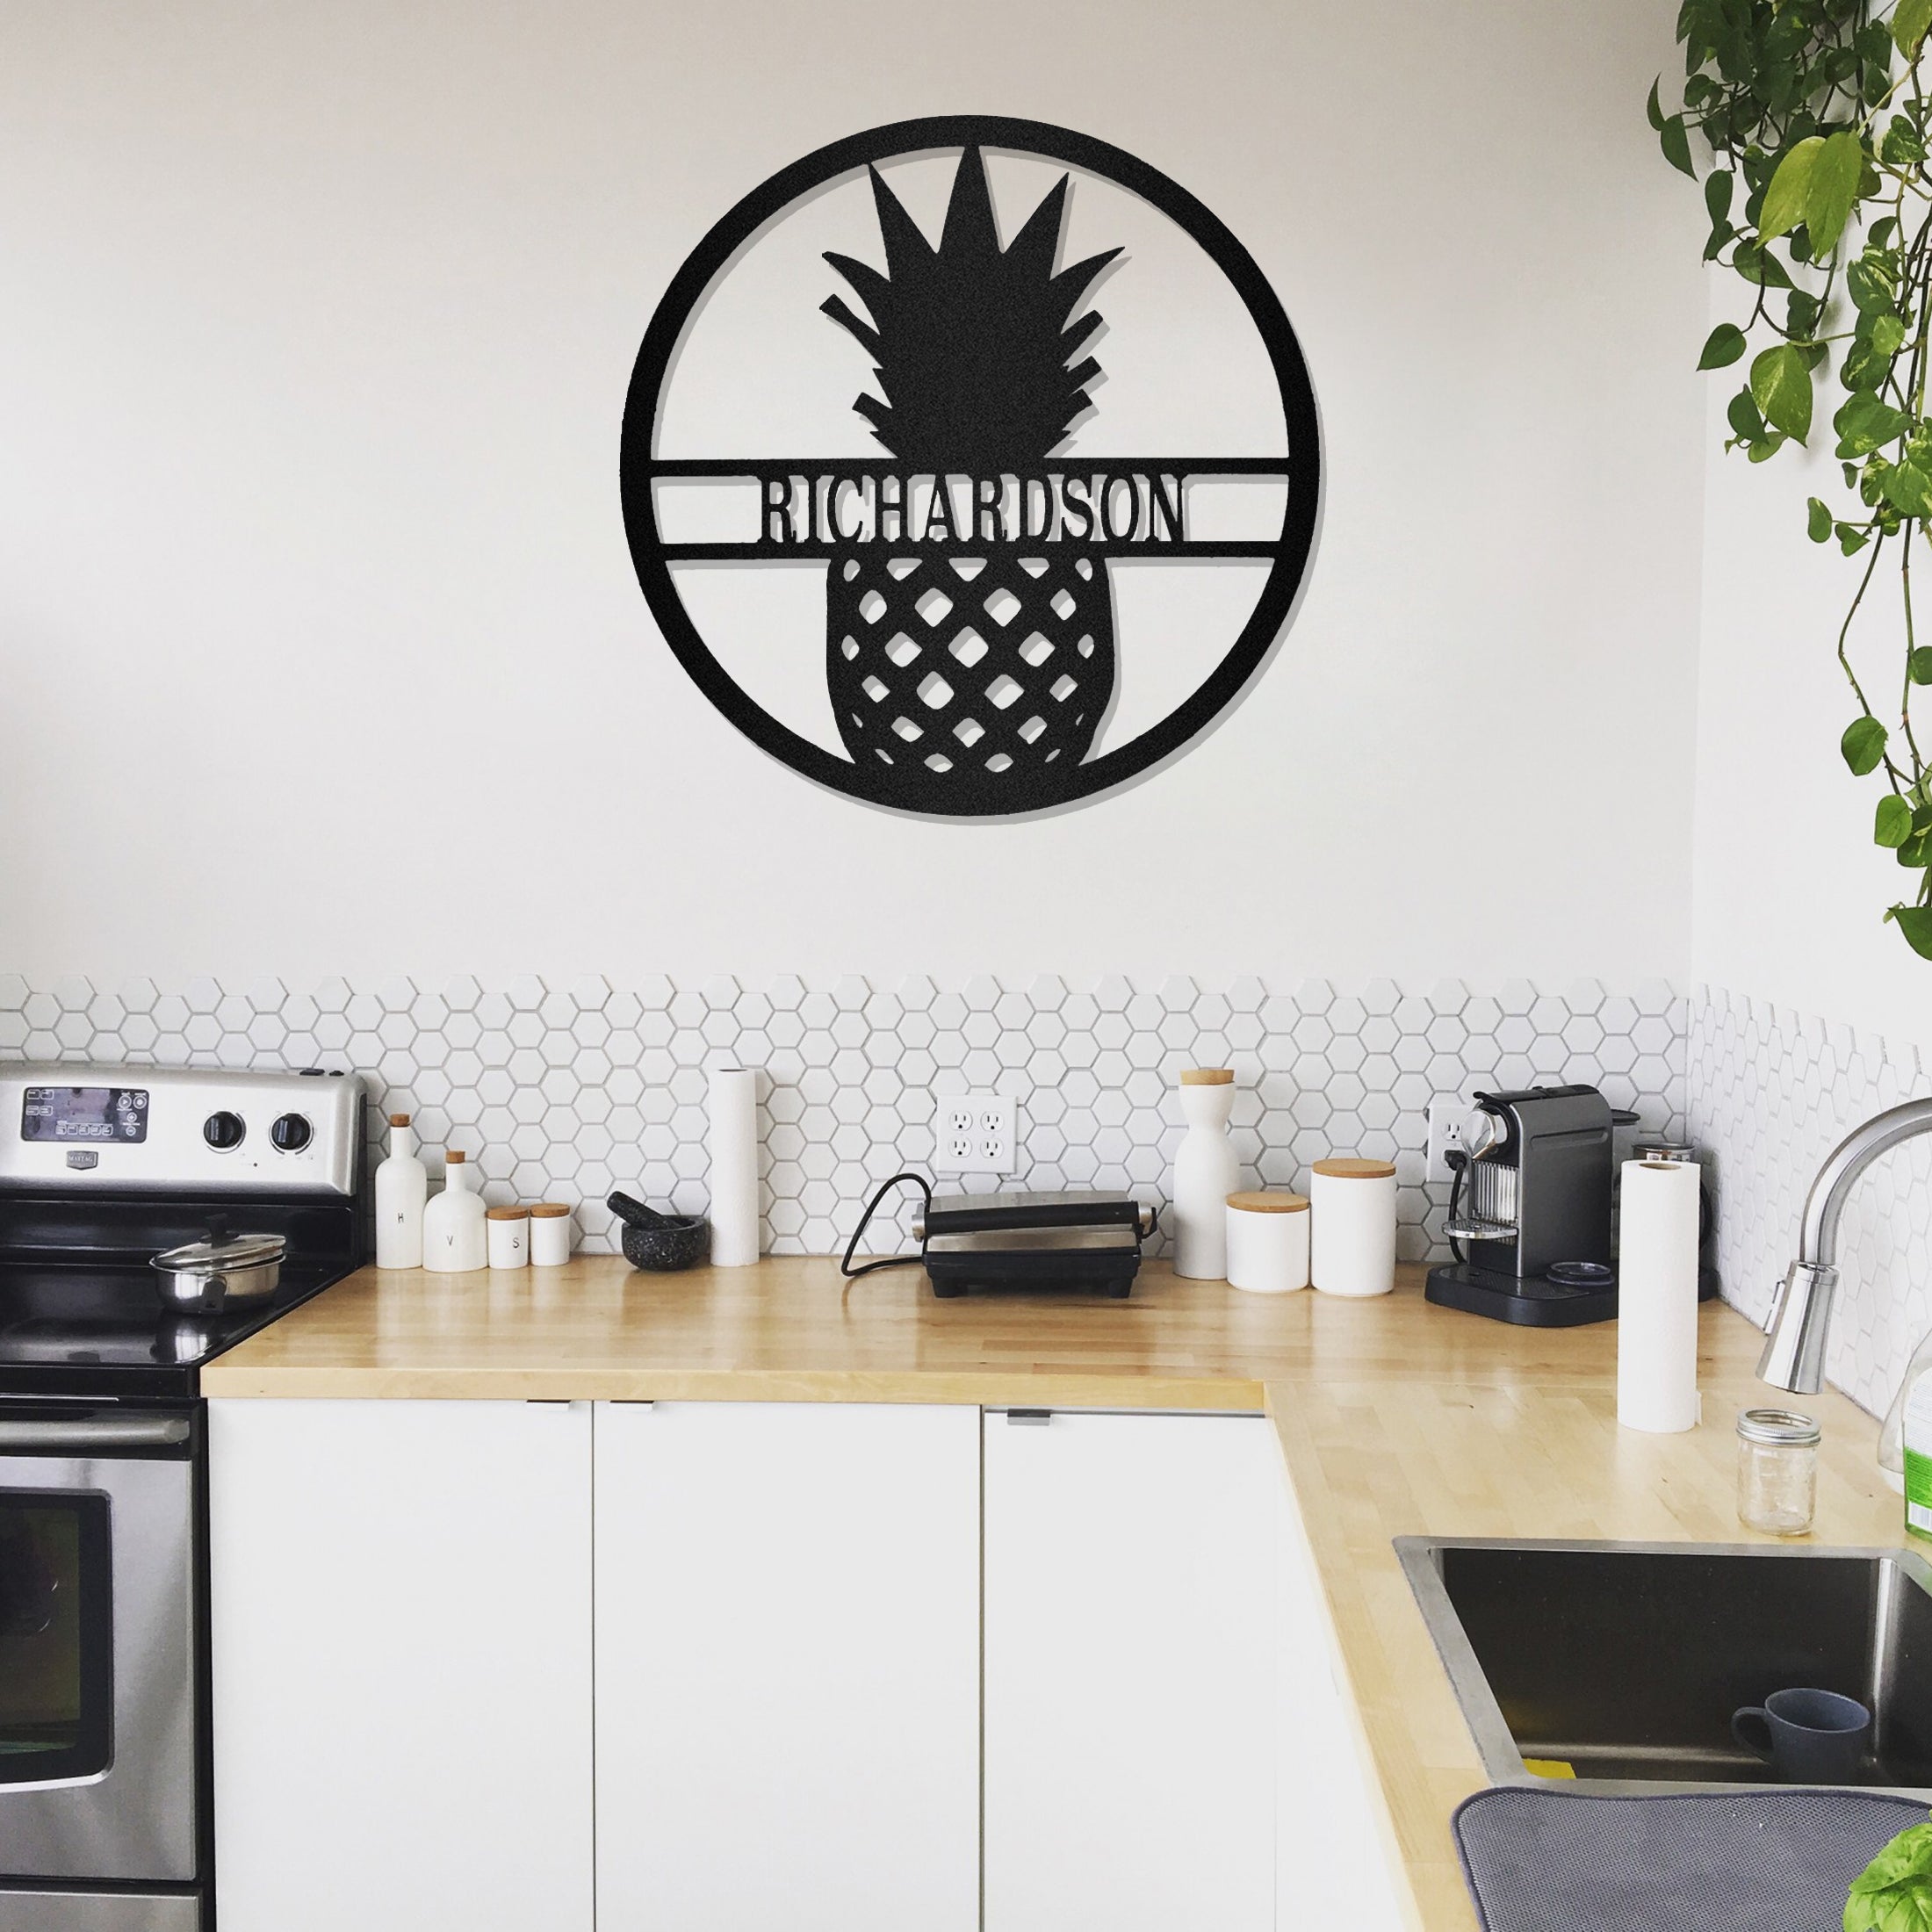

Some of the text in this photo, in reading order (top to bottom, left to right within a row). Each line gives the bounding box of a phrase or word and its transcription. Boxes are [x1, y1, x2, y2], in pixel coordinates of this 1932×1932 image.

[759, 472, 1185, 544] RICHARDSON
[397, 1213, 405, 1223] H
[446, 1236, 454, 1246] V
[512, 1236, 521, 1249] S
